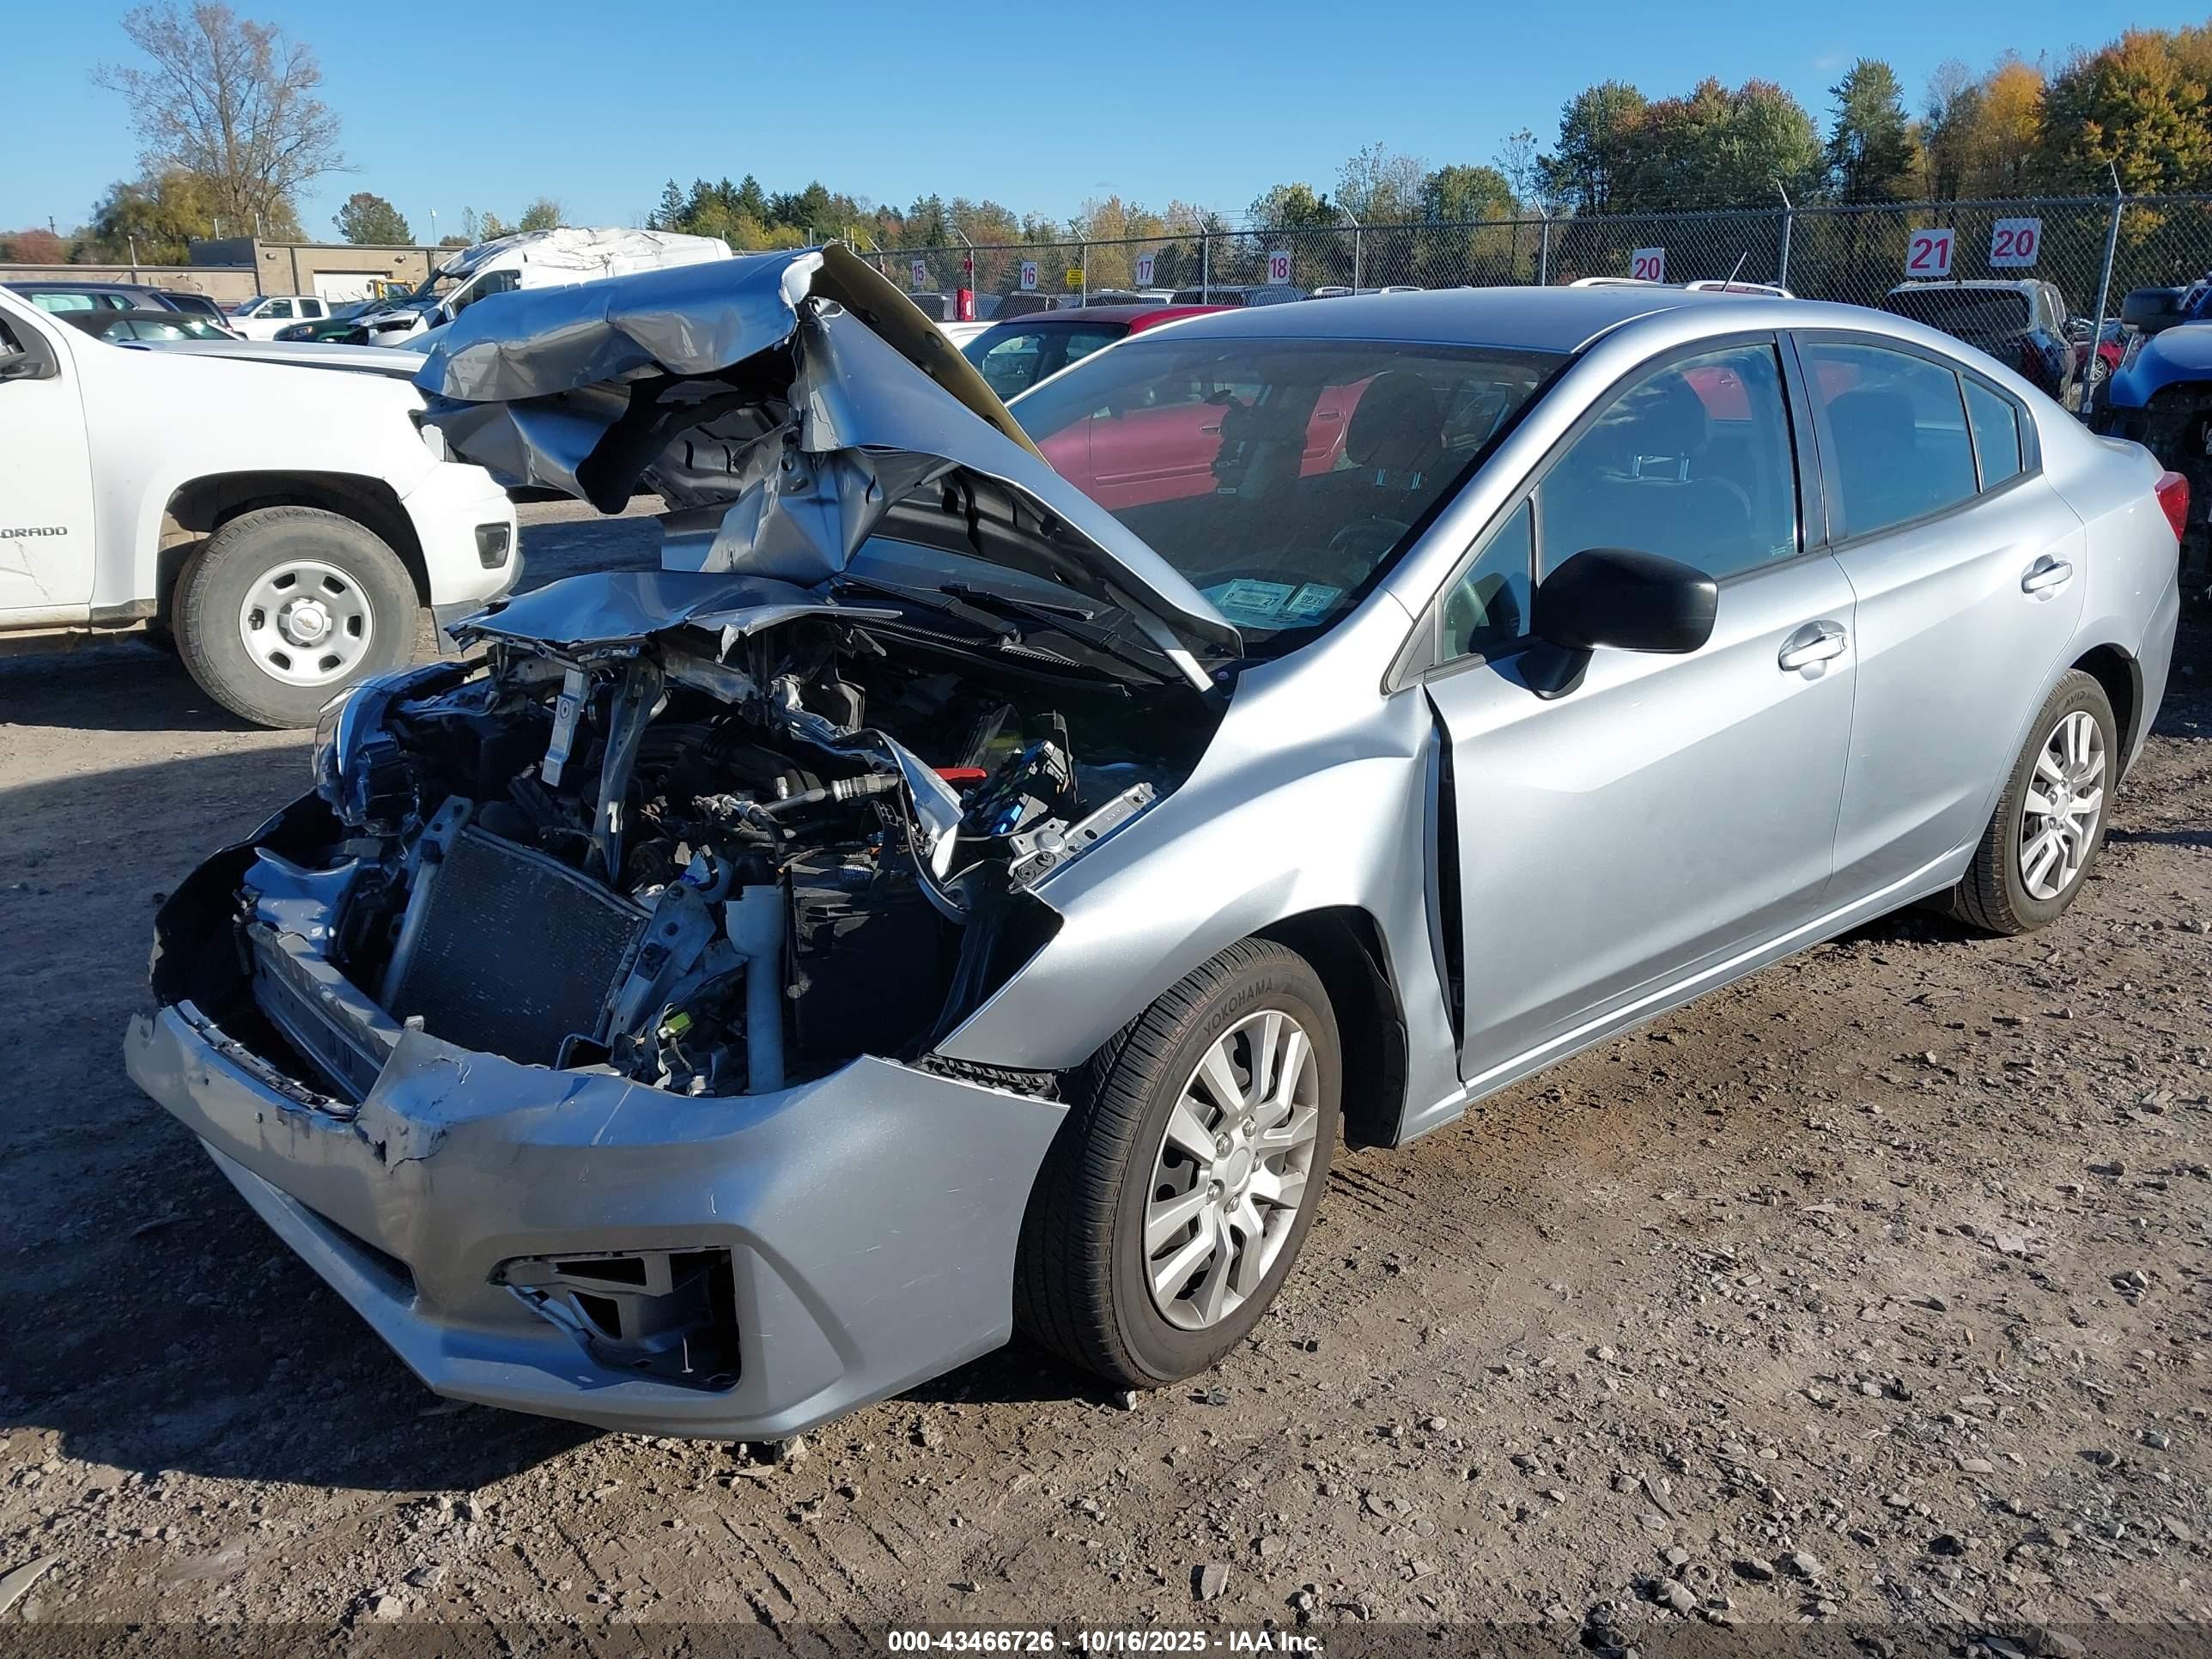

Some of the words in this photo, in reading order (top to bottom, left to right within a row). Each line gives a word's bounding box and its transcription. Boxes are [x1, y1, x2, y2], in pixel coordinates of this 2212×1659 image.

[1911, 238, 1948, 269] 21
[1994, 229, 2034, 257] 20
[913, 265, 924, 282] 15
[1023, 267, 1035, 285] 16
[1139, 260, 1152, 280] 17
[1270, 257, 1287, 279] 18
[1634, 257, 1661, 281] 20
[1203, 978, 1273, 1036] YOKOHAMA
